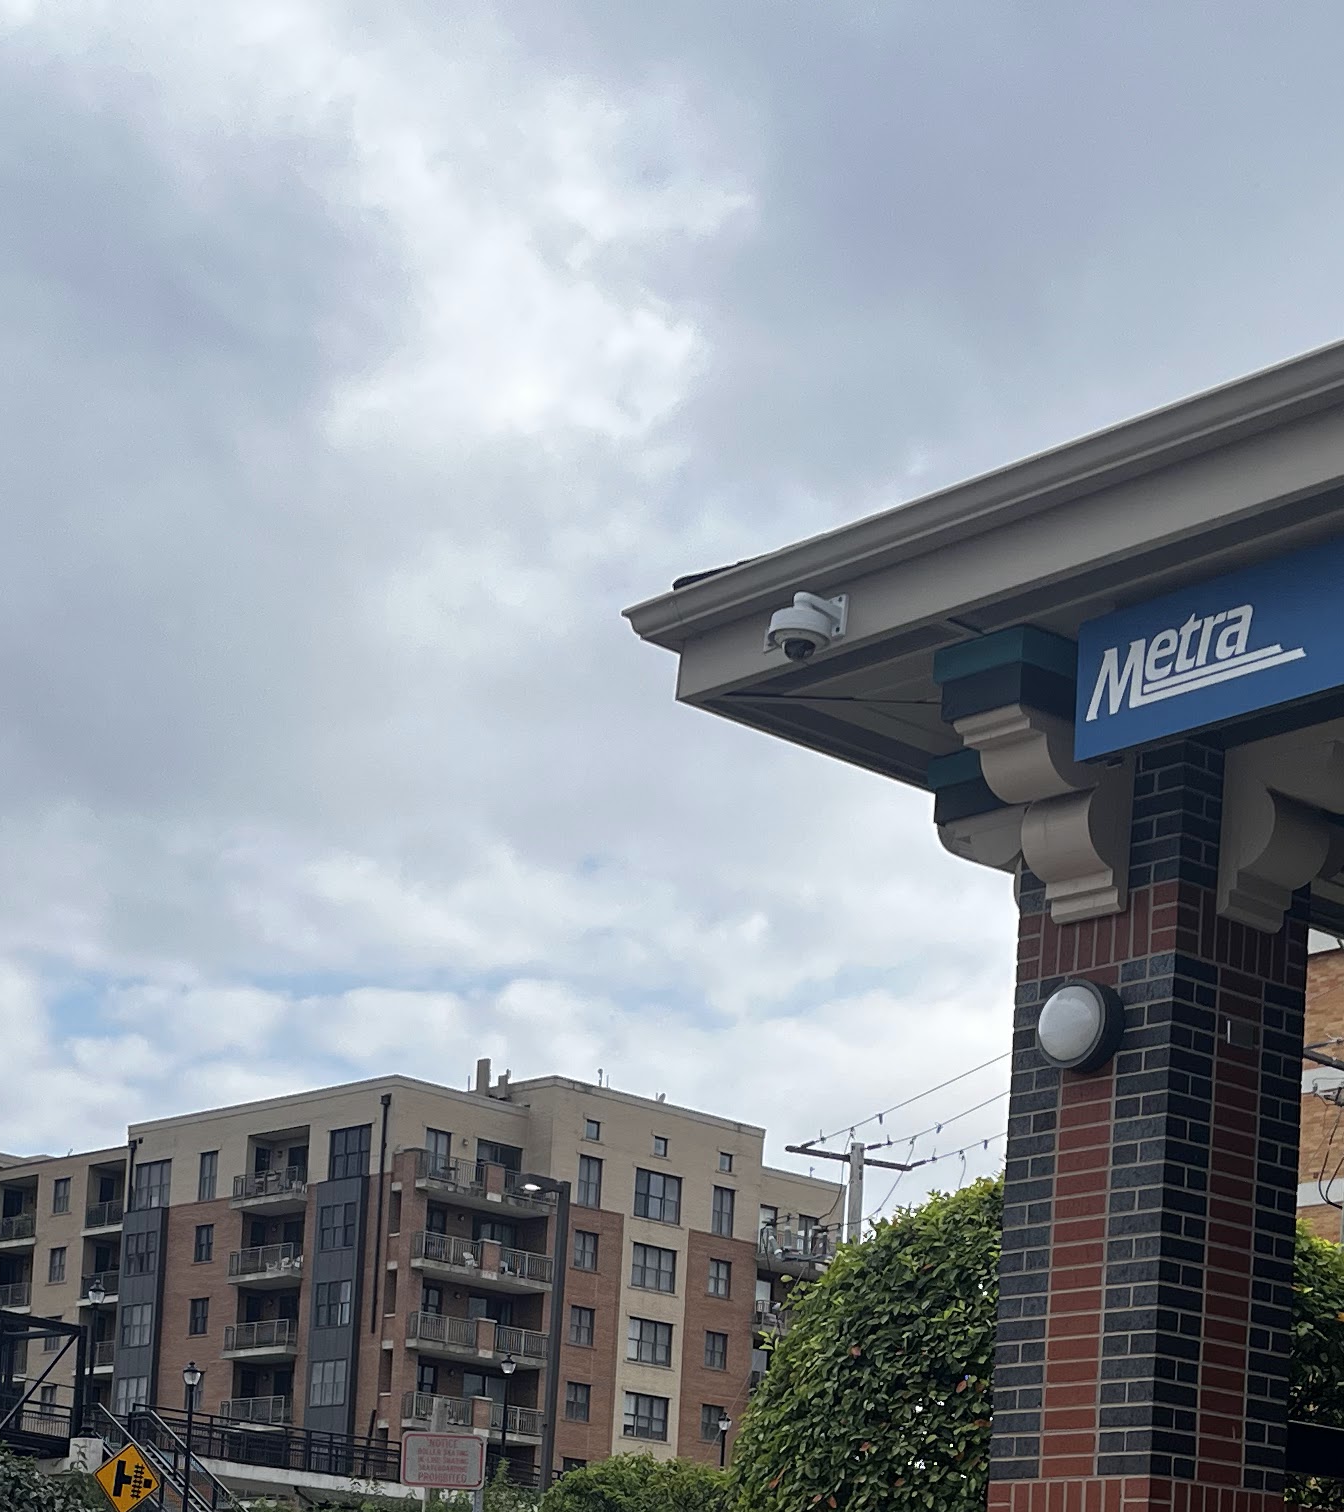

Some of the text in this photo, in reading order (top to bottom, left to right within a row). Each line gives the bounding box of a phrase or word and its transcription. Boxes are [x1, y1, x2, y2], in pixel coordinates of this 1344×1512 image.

[1085, 604, 1301, 722] Metra
[428, 1439, 458, 1449] NOTICE
[418, 1472, 468, 1484] PROHIBITED
